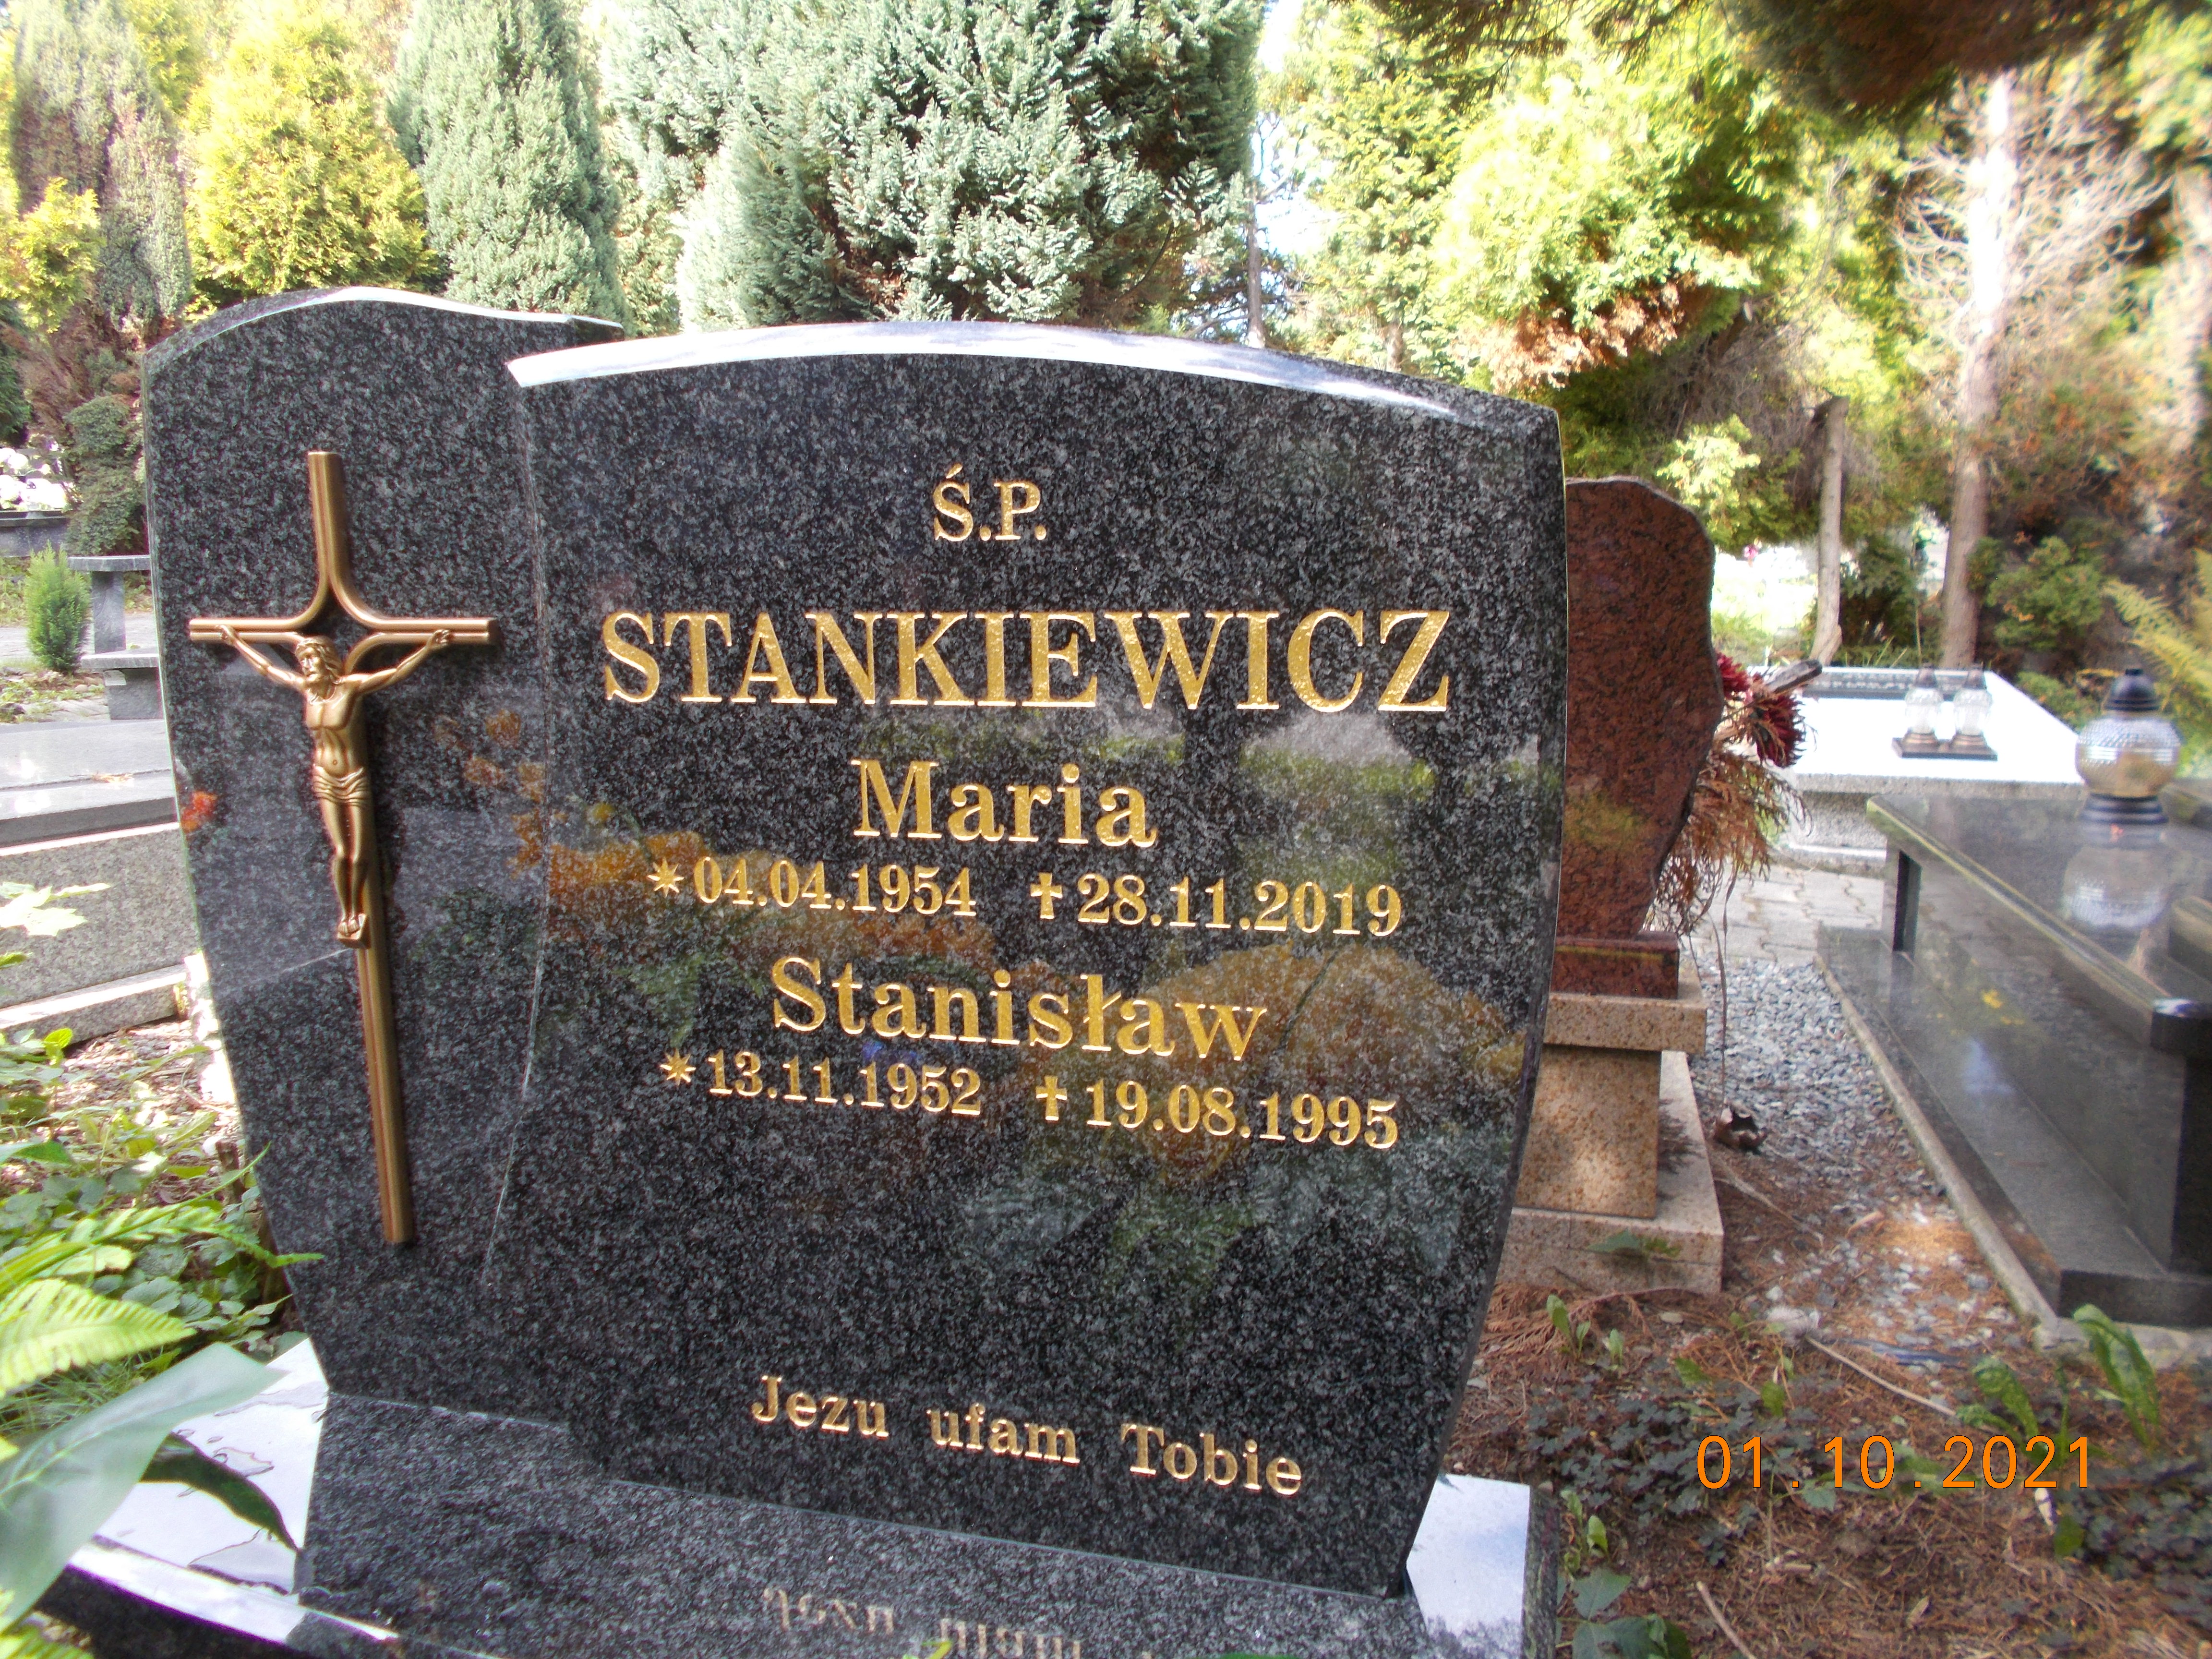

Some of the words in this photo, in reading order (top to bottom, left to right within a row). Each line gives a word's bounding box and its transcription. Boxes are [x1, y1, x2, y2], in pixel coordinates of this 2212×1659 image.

[933, 464, 1047, 542] Ś.P.
[602, 609, 1451, 713] STANKIEWICZ
[851, 758, 1157, 848] Maria
[695, 856, 977, 916] 04.04.1954
[1077, 873, 1402, 937] 28.11.2019
[771, 957, 1268, 1061] Stanisław
[708, 1049, 981, 1115] 13.11.1952
[1086, 1079, 1398, 1149] 19.08.1995
[752, 1375, 889, 1438] Jezu
[926, 1403, 1080, 1464] ufam
[1120, 1423, 1302, 1495] Tobie
